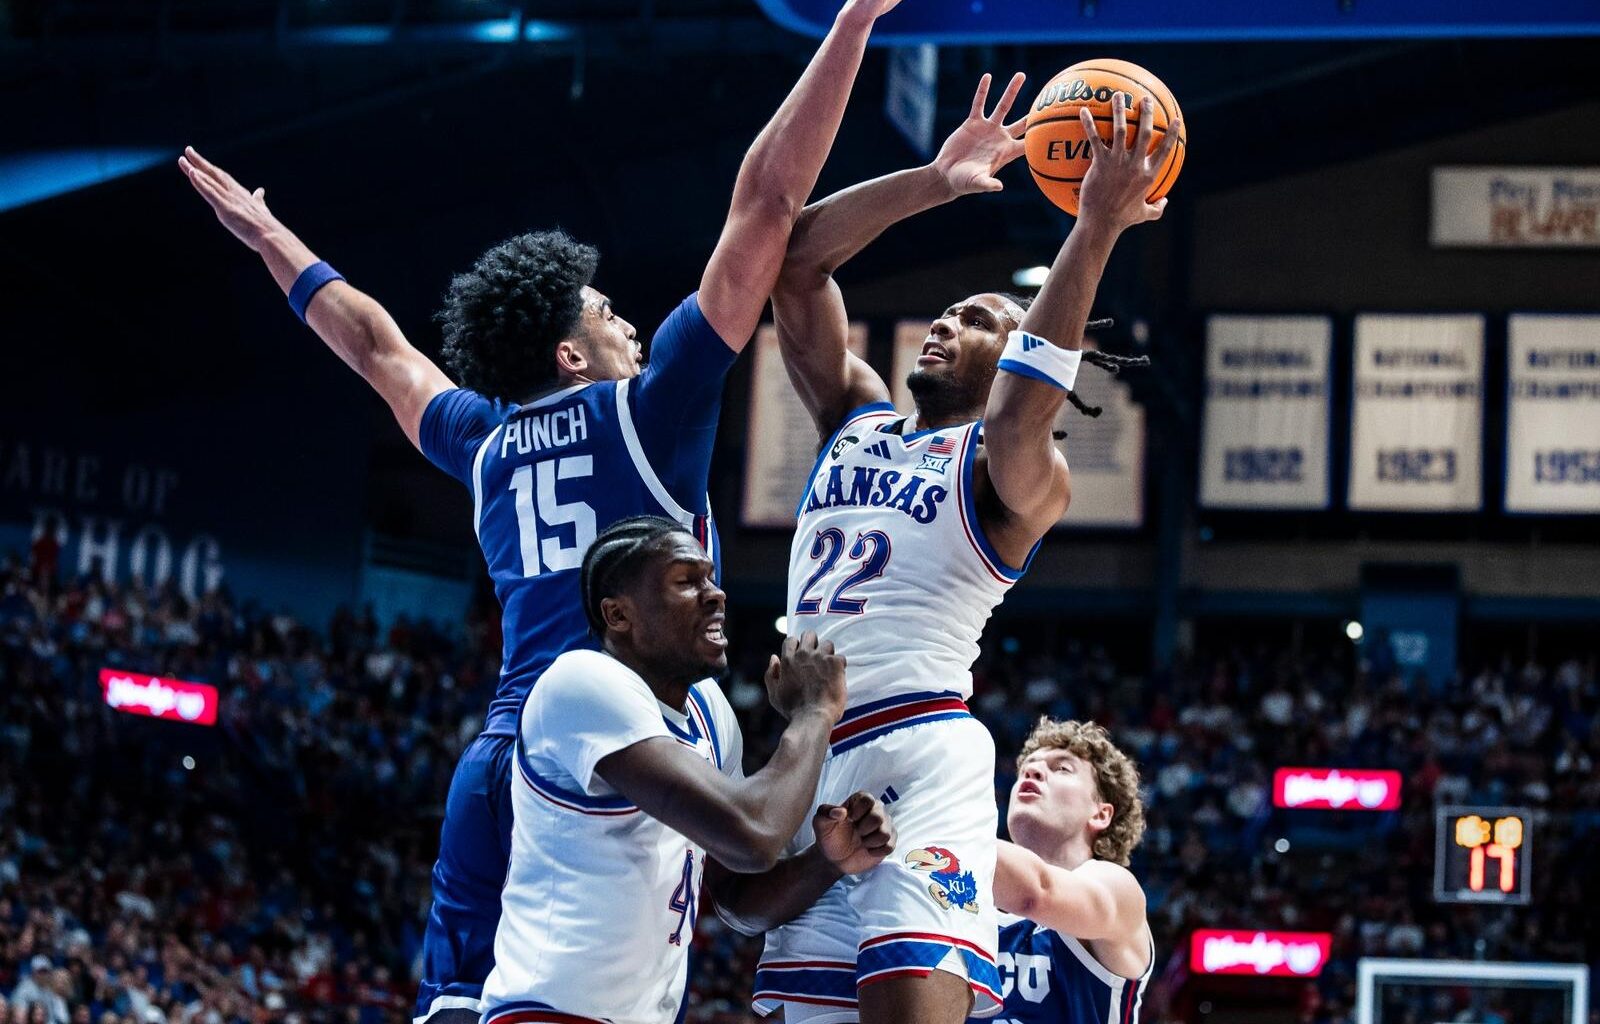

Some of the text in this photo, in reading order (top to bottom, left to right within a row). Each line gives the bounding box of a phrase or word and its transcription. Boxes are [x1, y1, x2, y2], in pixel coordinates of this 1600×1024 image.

[1036, 80, 1134, 112] Wilson
[501, 404, 587, 458] PUNCH
[1377, 448, 1456, 483] 1923
[508, 455, 597, 578] 15
[794, 527, 892, 615] 22
[949, 879, 966, 895] KU
[1470, 844, 1514, 892] 17
[669, 849, 706, 947] 4
